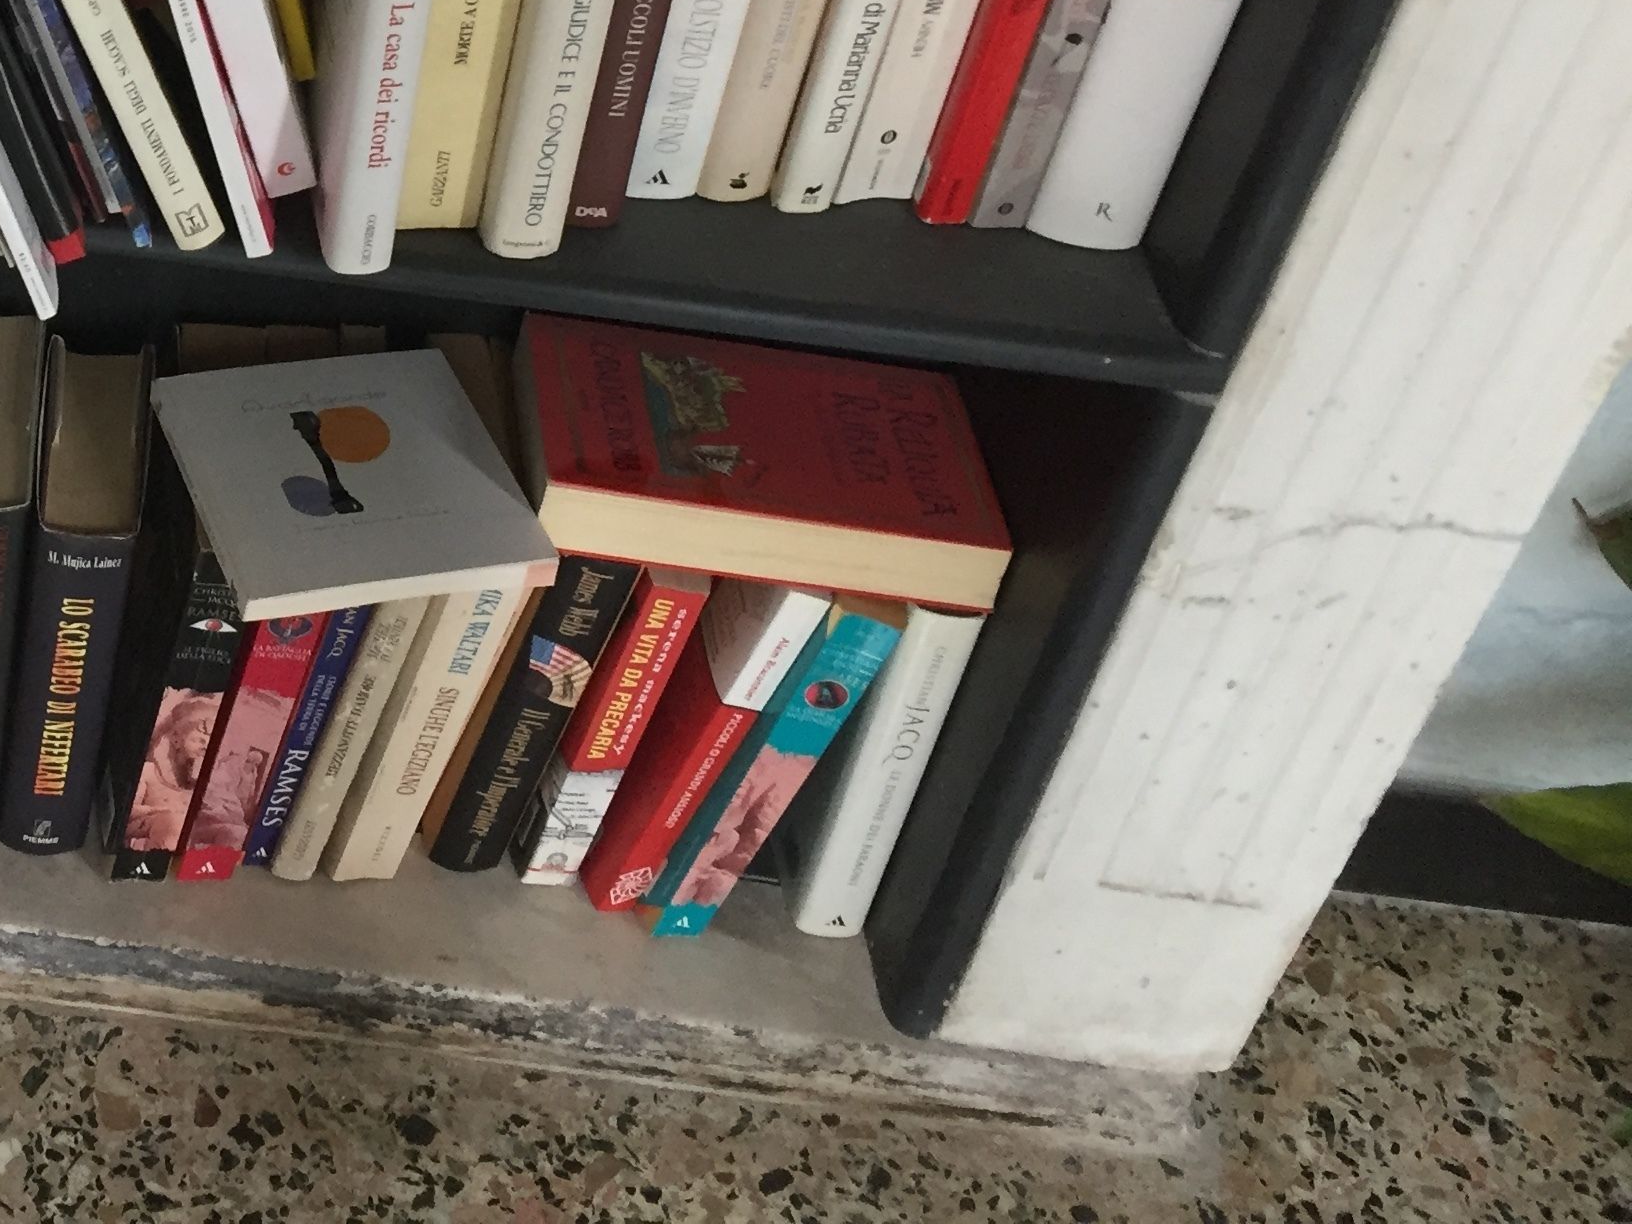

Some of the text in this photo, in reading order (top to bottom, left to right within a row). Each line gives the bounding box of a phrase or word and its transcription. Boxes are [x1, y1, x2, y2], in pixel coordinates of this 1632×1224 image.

[390, 1, 416, 26] La
[454, 16, 478, 65] MORTE
[382, 32, 403, 72] casa
[837, 20, 883, 98] Marianna
[100, 29, 180, 187] FONDAMENTI DEGLI SCACCHI
[379, 77, 401, 106] dei
[608, 50, 642, 119] UOMINI
[652, 75, 701, 155] D'INVERNO
[823, 91, 856, 135] Ucria
[368, 109, 394, 171] ricordi
[524, 102, 567, 227] CONDOTTIERO
[430, 149, 452, 208] GARZANTI
[62, 554, 92, 569] Mujica
[558, 566, 615, 638] James Webb
[448, 621, 490, 676] WALTARI
[586, 597, 675, 759] UNA VITA DA PRECARIA
[33, 597, 95, 796] LO SCARABEO DI NEFERTARI
[430, 686, 460, 733] SINUHE
[612, 608, 688, 756] serena mackesy
[503, 718, 545, 763] Generale
[695, 713, 744, 788] PICCOLI GRANDI
[883, 703, 929, 765] JACQ
[262, 748, 311, 827] RAMSES
[23, 834, 60, 844] PIEMME
